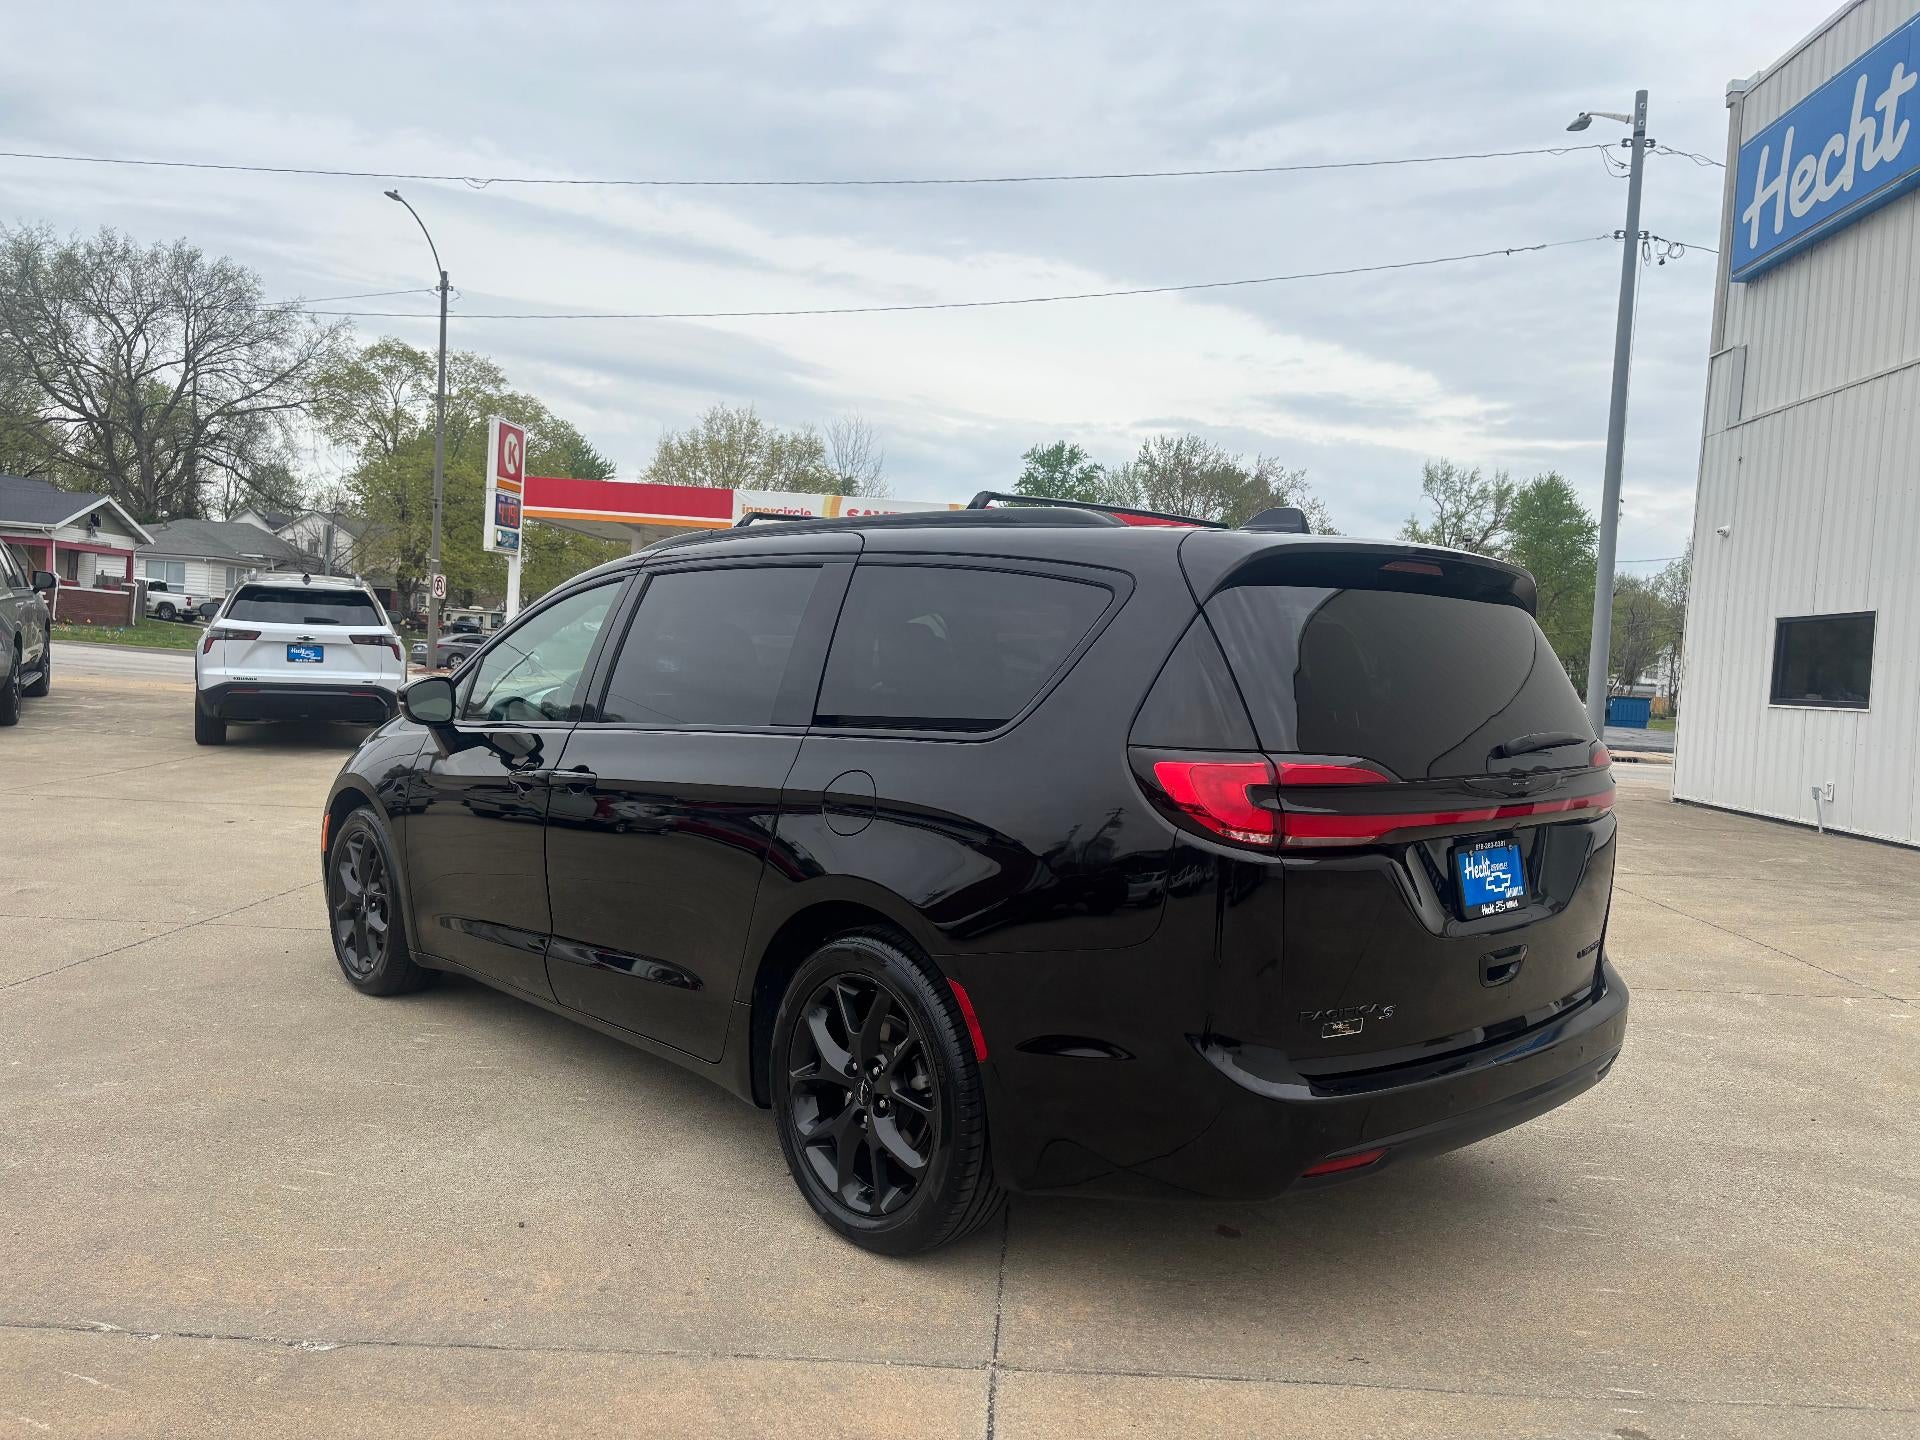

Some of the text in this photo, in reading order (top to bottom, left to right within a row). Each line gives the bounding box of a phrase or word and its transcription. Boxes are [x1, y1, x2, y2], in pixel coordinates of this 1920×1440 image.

[1742, 62, 1918, 249] Hecht
[508, 441, 519, 471] K
[1464, 855, 1491, 880] Hecht
